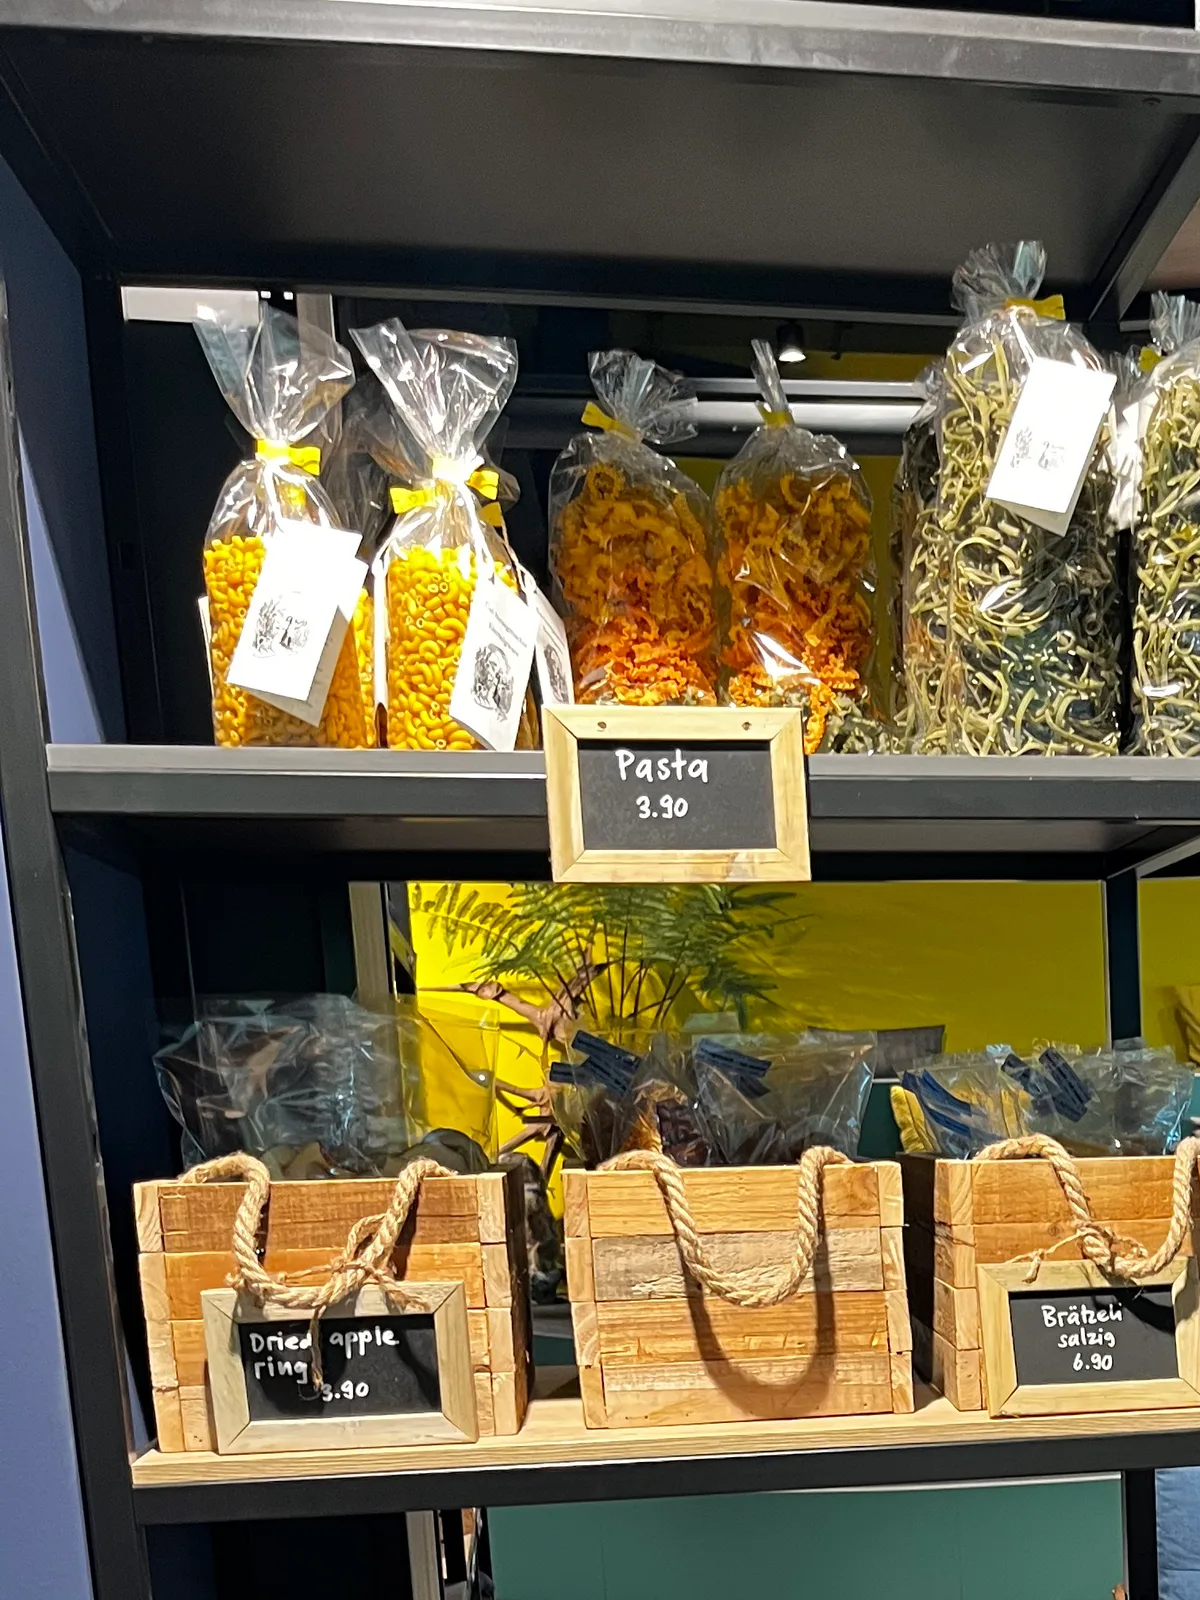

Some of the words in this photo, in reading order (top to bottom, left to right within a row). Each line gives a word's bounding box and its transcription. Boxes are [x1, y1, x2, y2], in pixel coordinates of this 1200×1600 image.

[615, 748, 708, 783] Pasta
[635, 793, 689, 819] 3.90
[1040, 1302, 1123, 1328] Brätzeli
[249, 1331, 312, 1354] Dried
[329, 1325, 400, 1359] apple
[1057, 1327, 1116, 1349] salzig
[253, 1356, 308, 1385] ring
[1072, 1352, 1113, 1371] 6.90
[321, 1380, 369, 1402] 3.90
